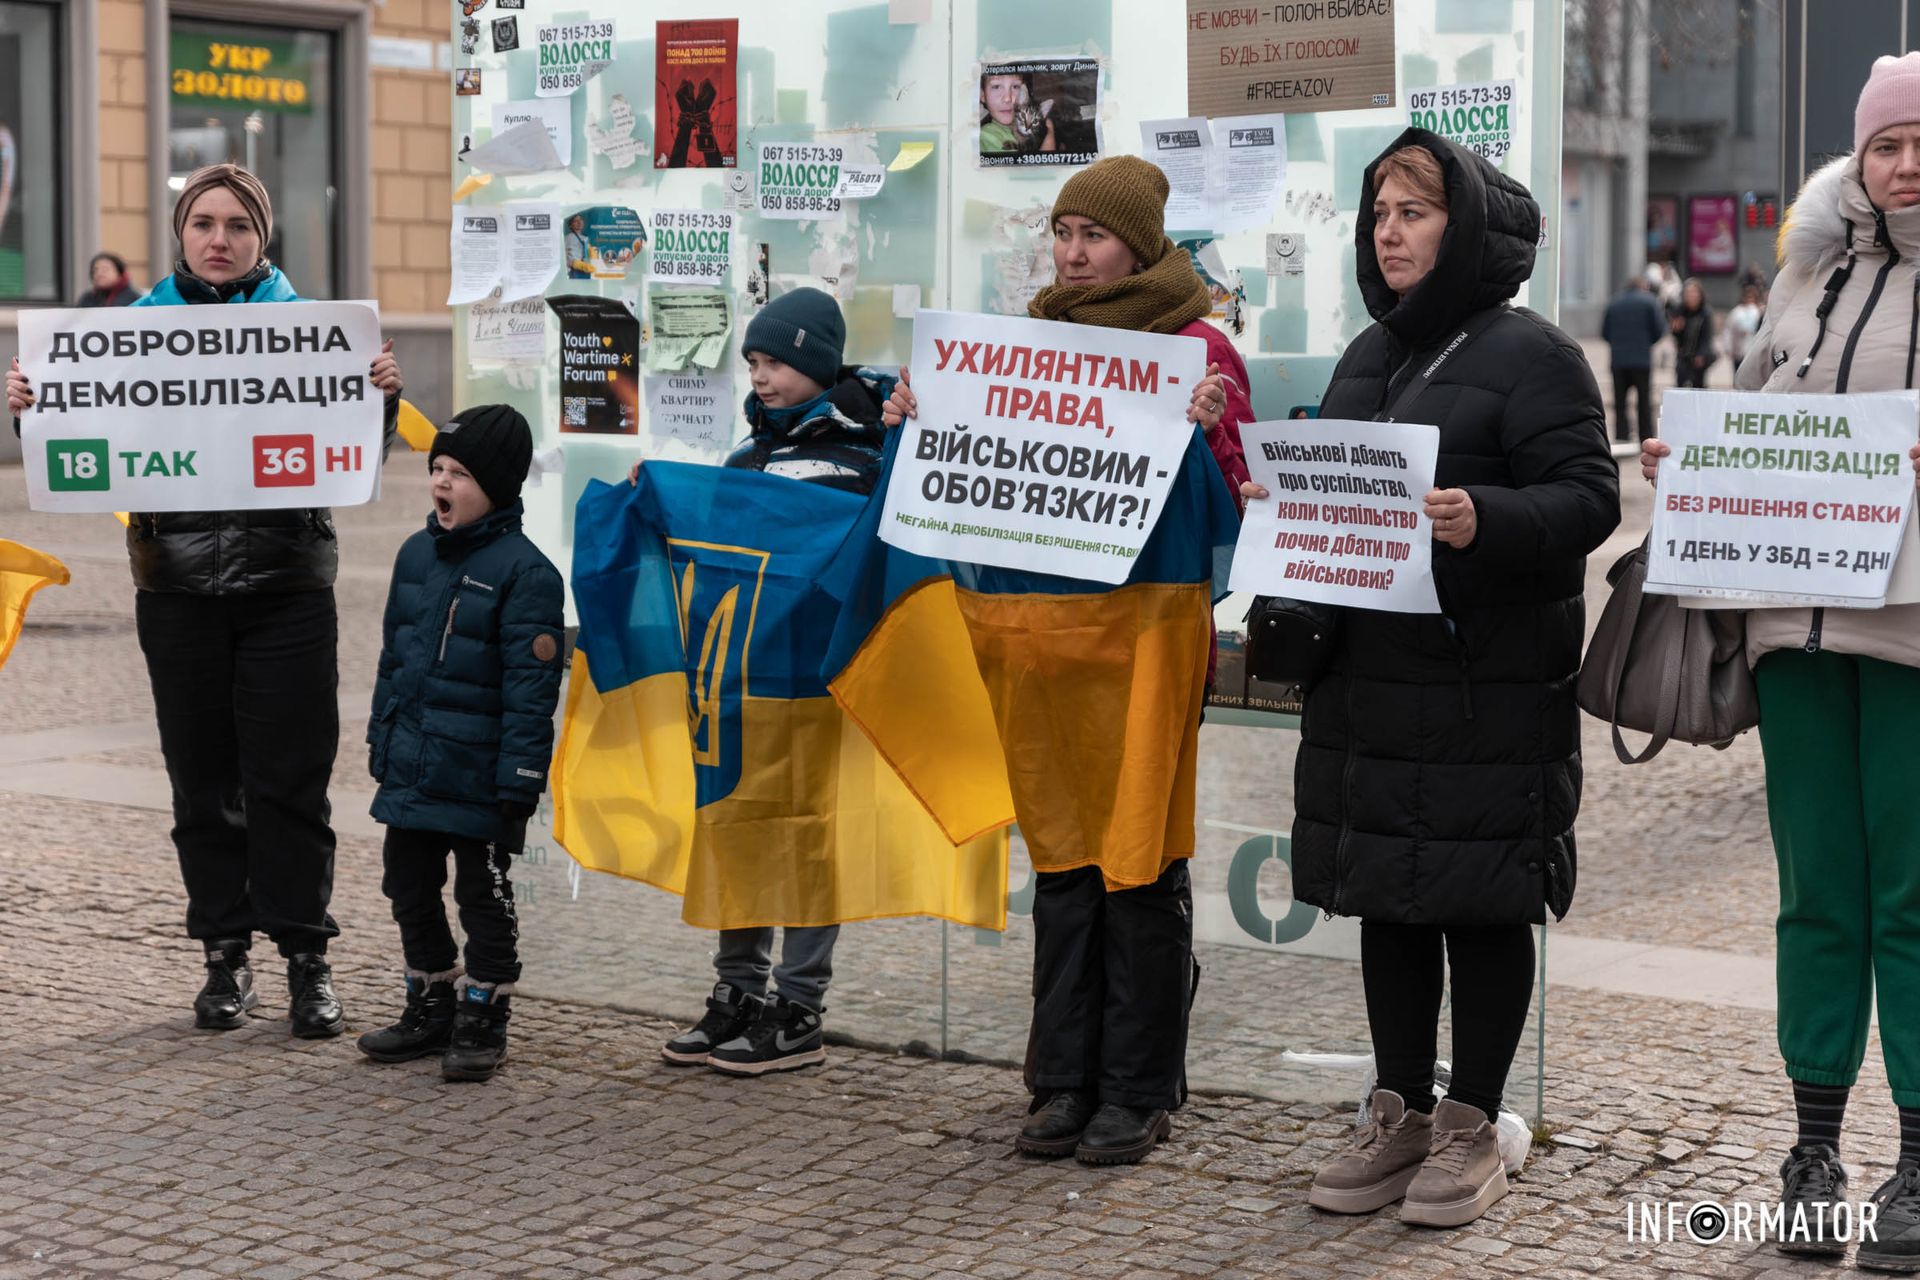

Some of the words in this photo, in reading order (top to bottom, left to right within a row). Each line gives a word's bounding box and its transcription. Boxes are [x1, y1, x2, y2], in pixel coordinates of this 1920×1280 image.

[1189, 12, 1208, 31] НЕ
[1211, 8, 1258, 29] МОВЧИ
[1274, 2, 1324, 24] ПОЛОН
[1328, 0, 1391, 21] ВБИВАЄ!
[539, 26, 559, 42] 067
[561, 22, 613, 40] 515-73-39
[208, 42, 272, 72] УКР
[539, 39, 612, 67] ВОЛОССЯ
[1220, 45, 1260, 68] БУДЬ
[1263, 38, 1281, 63] ЇХ
[1285, 37, 1360, 61] ГОЛОСОМ!
[539, 65, 577, 78] купуємо
[1017, 64, 1049, 73] мальчик,
[1050, 63, 1071, 72] зовут
[172, 68, 307, 105] ЗОЛОТО
[540, 75, 559, 90] 050
[1247, 77, 1335, 100] #FREEAZOV
[1411, 92, 1437, 109] 067
[1441, 85, 1512, 106] 515-73-39
[504, 114, 532, 125] Куплю
[1410, 104, 1509, 135] ВОЛОССЯ
[1466, 131, 1510, 145] дорого
[763, 146, 784, 160] 067
[787, 147, 843, 162] 515-73-39
[761, 162, 840, 188] ВОЛОССЯ
[848, 173, 882, 184] РАБОТА
[760, 186, 801, 198] купуємо
[804, 189, 834, 198] дорог
[762, 196, 782, 210] 050
[785, 197, 841, 212] 858-96-29
[655, 213, 677, 228] 067
[678, 213, 732, 229] 515-73-39
[654, 228, 730, 255] ВОЛОССЯ
[653, 252, 694, 264] купуємо
[695, 253, 729, 265] дорого
[653, 262, 675, 276] 050
[48, 325, 352, 363] ДОБРОВІЛЬНА
[563, 332, 600, 348] Youth
[563, 349, 619, 365] Wartime
[934, 338, 1159, 395] УХИЛЯНТАМ
[563, 366, 605, 381] Forum
[668, 378, 707, 389] СНИМУ
[36, 375, 364, 413] ДЕМОБІЛІЗАЦІЯ
[660, 394, 716, 406] КВАРТИРУ
[985, 384, 1115, 439] ПРАВА,
[1723, 409, 1852, 439] НЕГАЙНА
[58, 451, 98, 480] 18
[118, 450, 198, 478] ТАК
[261, 447, 307, 475] 36
[325, 445, 362, 472] НІ
[915, 423, 1151, 488] ВІЙСЬКОВИМ
[1260, 440, 1347, 463] Військові
[1350, 443, 1408, 470] дбають
[1680, 444, 1900, 480] ДЕМОБІЛІЗАЦІЯ
[921, 469, 1151, 531] ОБОВ'ЯЗКИ?!
[1277, 472, 1308, 492] про
[1311, 473, 1412, 500] суспільство,
[1277, 501, 1318, 521] коли
[1322, 503, 1418, 530] суспільство
[1666, 494, 1704, 513] БЕЗ
[1708, 496, 1807, 519] РІШЕННЯ
[1812, 501, 1901, 524] СТАВКИ
[895, 511, 949, 532] НЕГАЙНА
[951, 522, 1033, 544] ДЕМОБІЛІЗАЦІЯ
[1034, 533, 1054, 546] БЕЗ
[1054, 535, 1101, 552] РІШЕННЯ
[1274, 532, 1329, 553] почне
[1330, 533, 1383, 559] дбати
[1386, 540, 1411, 562] про
[1666, 539, 1676, 557] 1
[1680, 540, 1741, 562] ДЕНЬ
[1747, 543, 1762, 562] У
[1766, 545, 1811, 569] ЗБД
[1817, 552, 1830, 563] =
[1835, 549, 1848, 568] 2
[1852, 550, 1891, 573] ДНІ
[1283, 559, 1394, 591] військових?
